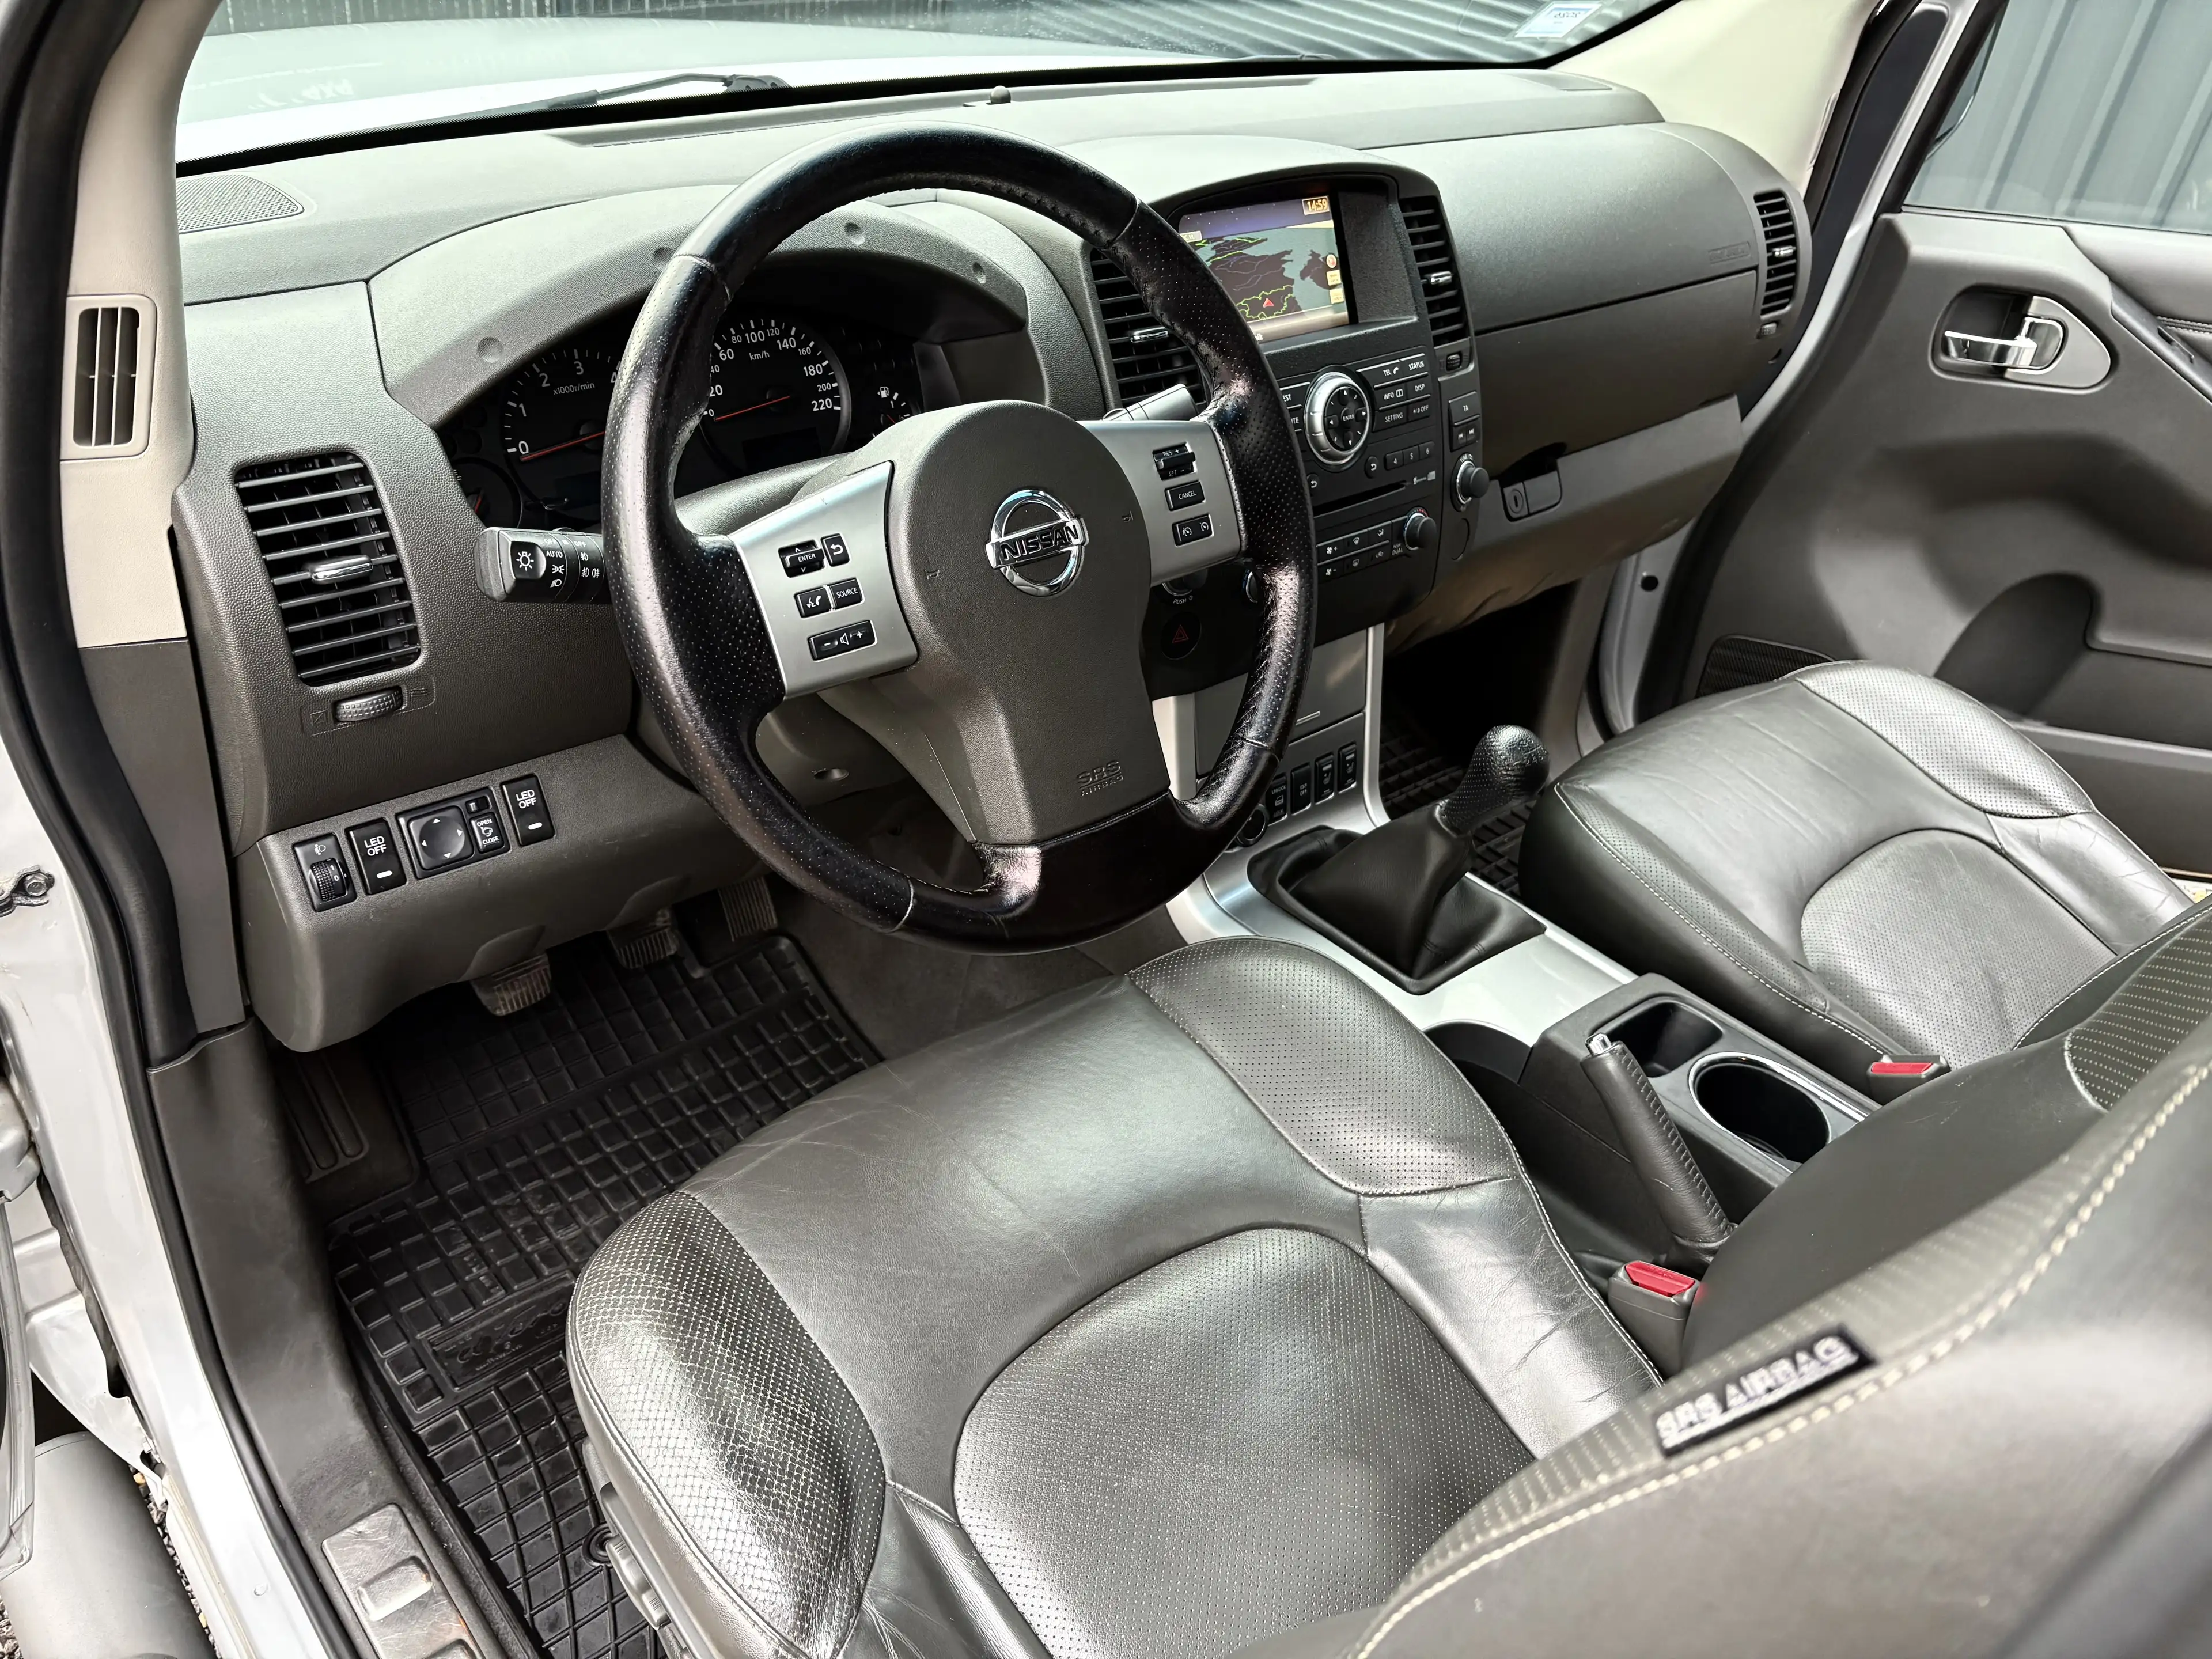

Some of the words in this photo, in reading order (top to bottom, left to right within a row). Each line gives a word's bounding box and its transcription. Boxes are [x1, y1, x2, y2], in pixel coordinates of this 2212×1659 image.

[1307, 199, 1327, 212] 14:59
[745, 330, 765, 343] 100
[767, 327, 780, 336] 120
[732, 335, 742, 343] 80
[777, 338, 796, 350] 140
[719, 349, 734, 361] 60
[749, 350, 770, 361] km/h
[798, 347, 812, 355] 160
[574, 361, 584, 375] 3
[803, 363, 823, 376] 180
[1408, 361, 1425, 370] STATUS
[539, 373, 551, 387] 2
[553, 381, 595, 395] x1000r/min
[709, 384, 723, 397] 20
[817, 382, 831, 392] 200
[1415, 384, 1425, 392] DISP
[519, 403, 527, 417] 1
[811, 398, 832, 411] 220
[1421, 404, 1429, 412] OFF
[1385, 412, 1403, 423] SETTING
[518, 441, 529, 454] 0
[1179, 490, 1196, 499] CANCEL
[999, 524, 1080, 562] NISSAN
[546, 550, 563, 558] AUTO
[798, 552, 816, 563] ENTER
[836, 587, 858, 598] SOURCE
[1077, 760, 1121, 785] SRS
[1271, 784, 1286, 794] UNLOCK
[516, 790, 535, 801] LED
[518, 797, 536, 809] OFF
[476, 819, 493, 827] OPEN
[364, 836, 385, 848] LED
[482, 836, 499, 844] CLOSE
[367, 844, 387, 856] OFF
[1656, 1392, 1723, 1440] SRS
[1725, 1336, 1858, 1408] AIRBAG
